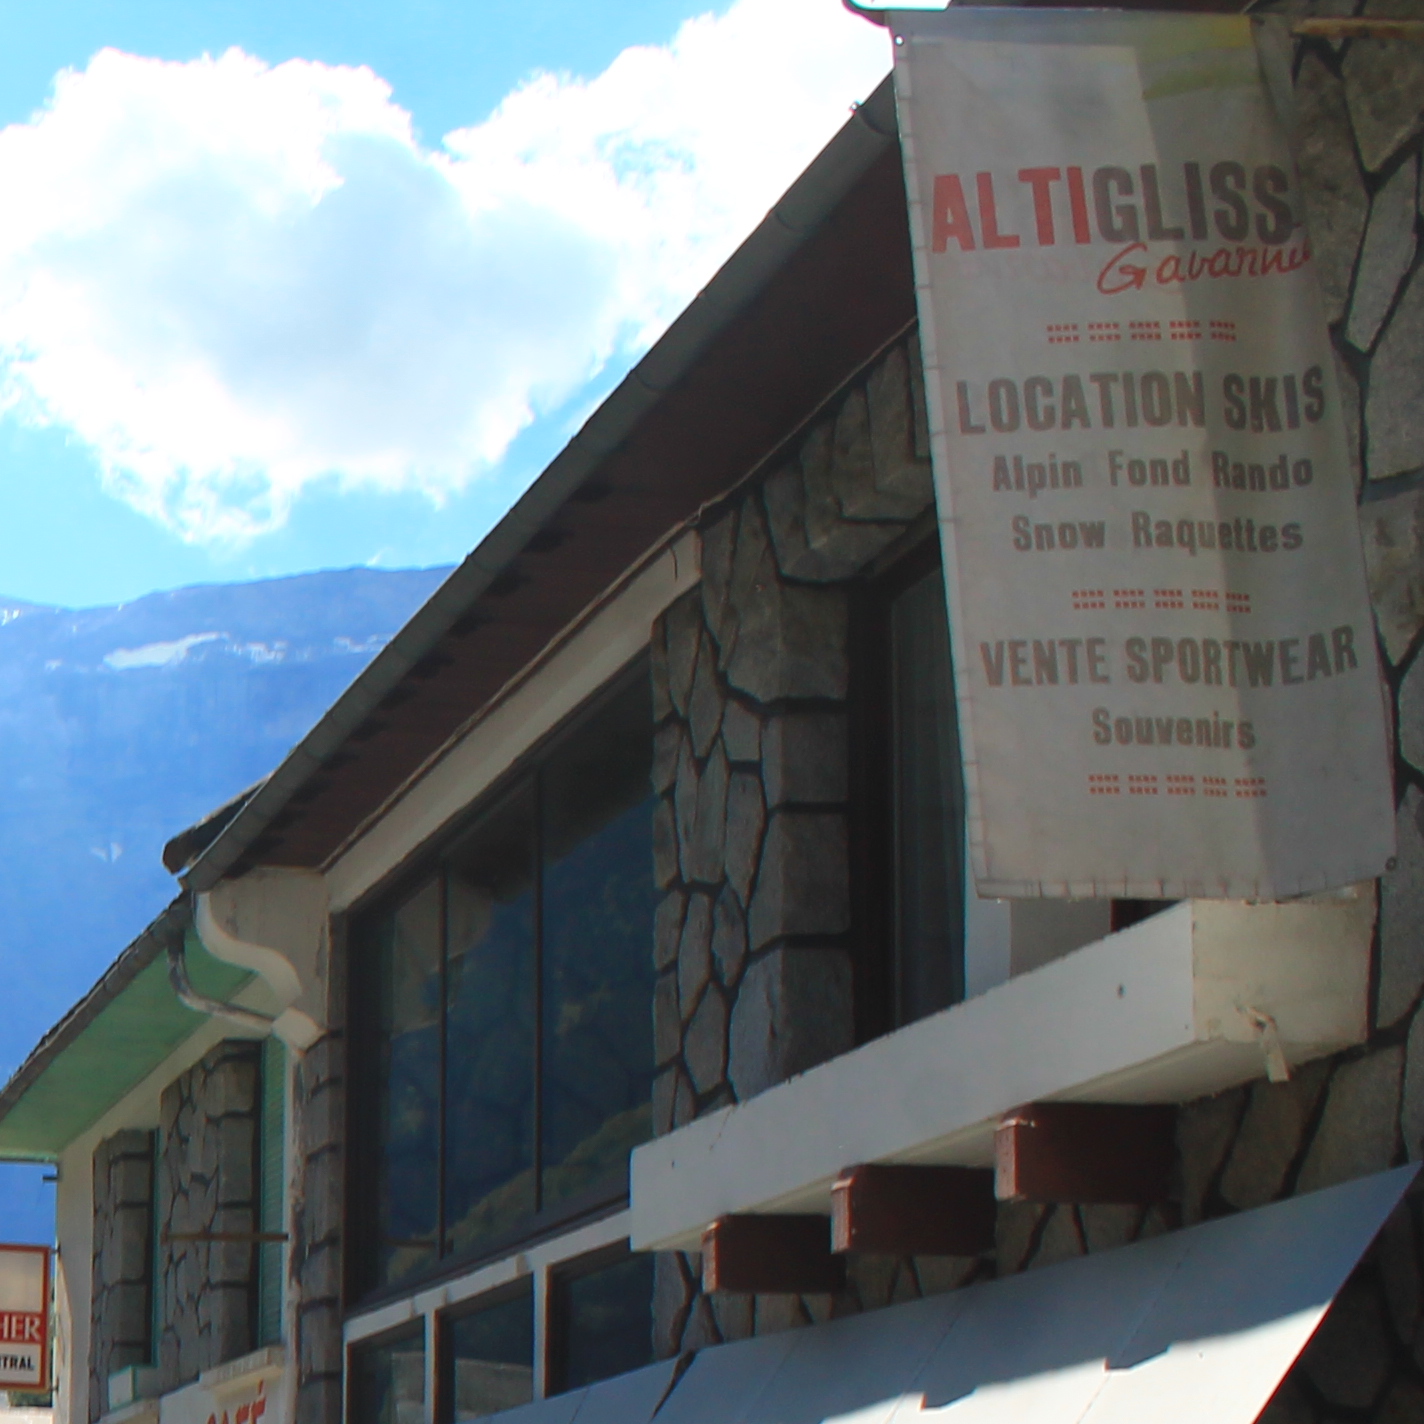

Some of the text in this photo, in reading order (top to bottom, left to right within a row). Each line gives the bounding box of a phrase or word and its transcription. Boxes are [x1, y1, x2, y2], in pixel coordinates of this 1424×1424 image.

[931, 160, 1296, 253] ALTIGLISS
[958, 366, 1325, 435] LOCATION SKIS
[992, 450, 1314, 500] Alpin Fond Rando
[1013, 512, 1304, 556] Snow Raquettes
[980, 626, 1358, 689] VENTE SPORTWEAR
[1091, 709, 1257, 750] Souvenirs
